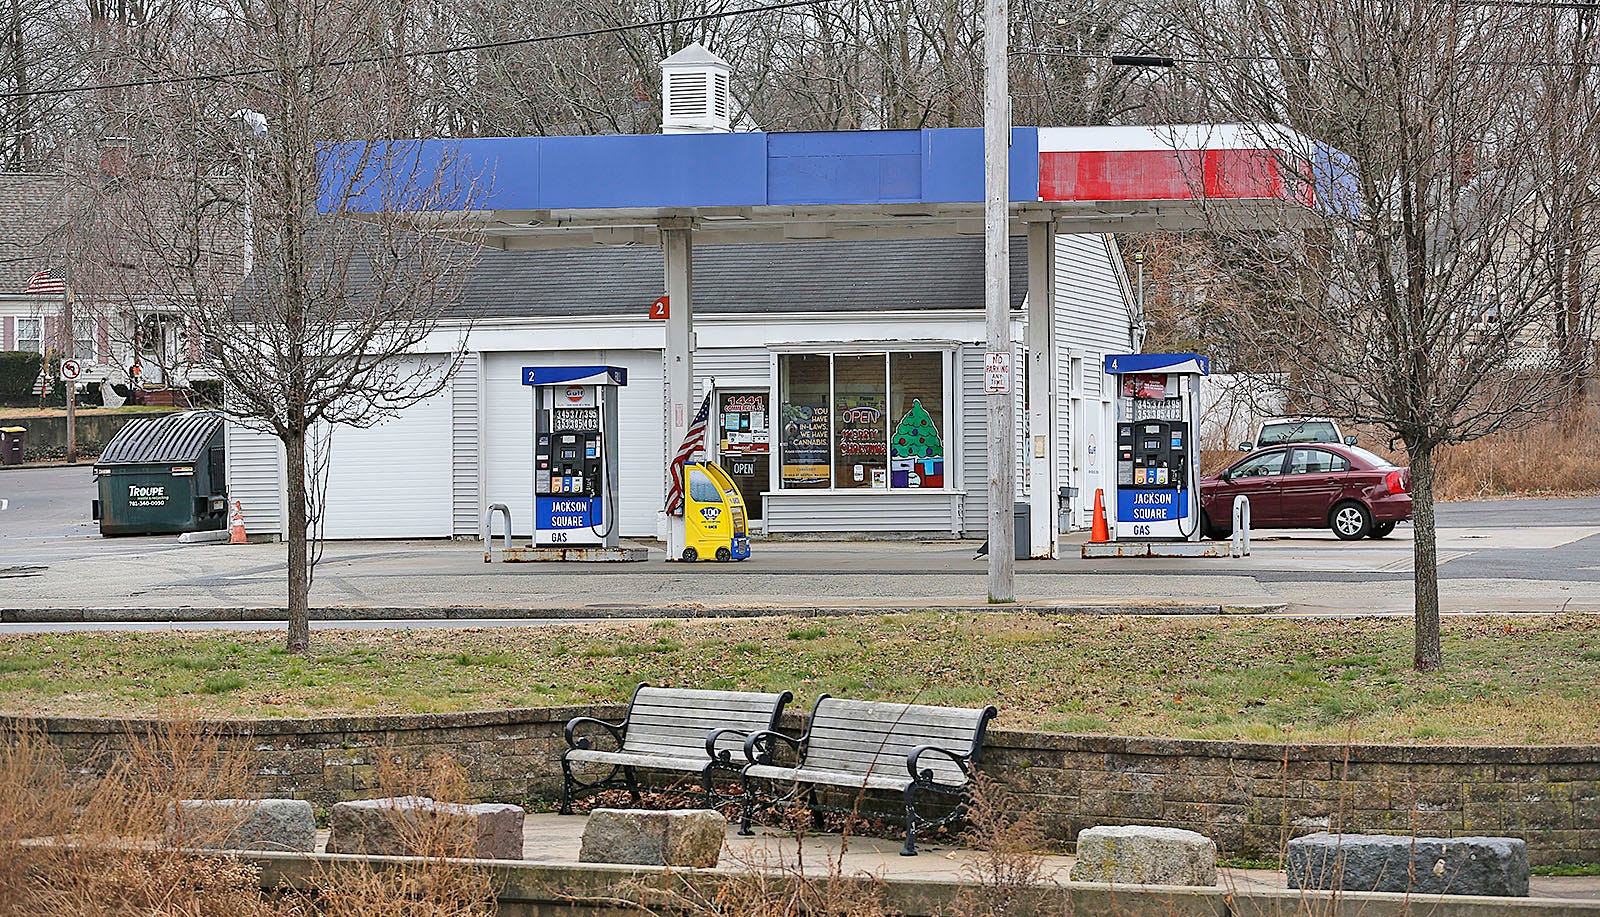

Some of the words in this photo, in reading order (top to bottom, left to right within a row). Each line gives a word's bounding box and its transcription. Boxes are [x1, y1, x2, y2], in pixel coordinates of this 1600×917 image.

[656, 302, 664, 314] 2
[992, 356, 1003, 364] NO
[1112, 359, 1118, 370] 4
[986, 365, 1008, 373] PARKING
[528, 371, 535, 382] 2
[728, 396, 763, 405] 1441
[843, 410, 878, 424] OPEN
[840, 428, 878, 441] MERRY
[734, 463, 754, 474] OPEN
[128, 485, 164, 497] TROUPE
[1133, 493, 1171, 504] JACKSON
[551, 501, 587, 512] JACKSON
[704, 508, 719, 516] 100
[1133, 508, 1167, 519] SQUARE
[551, 516, 583, 527] SQUARE
[1133, 525, 1150, 535] GAS
[551, 533, 568, 542] GAS
